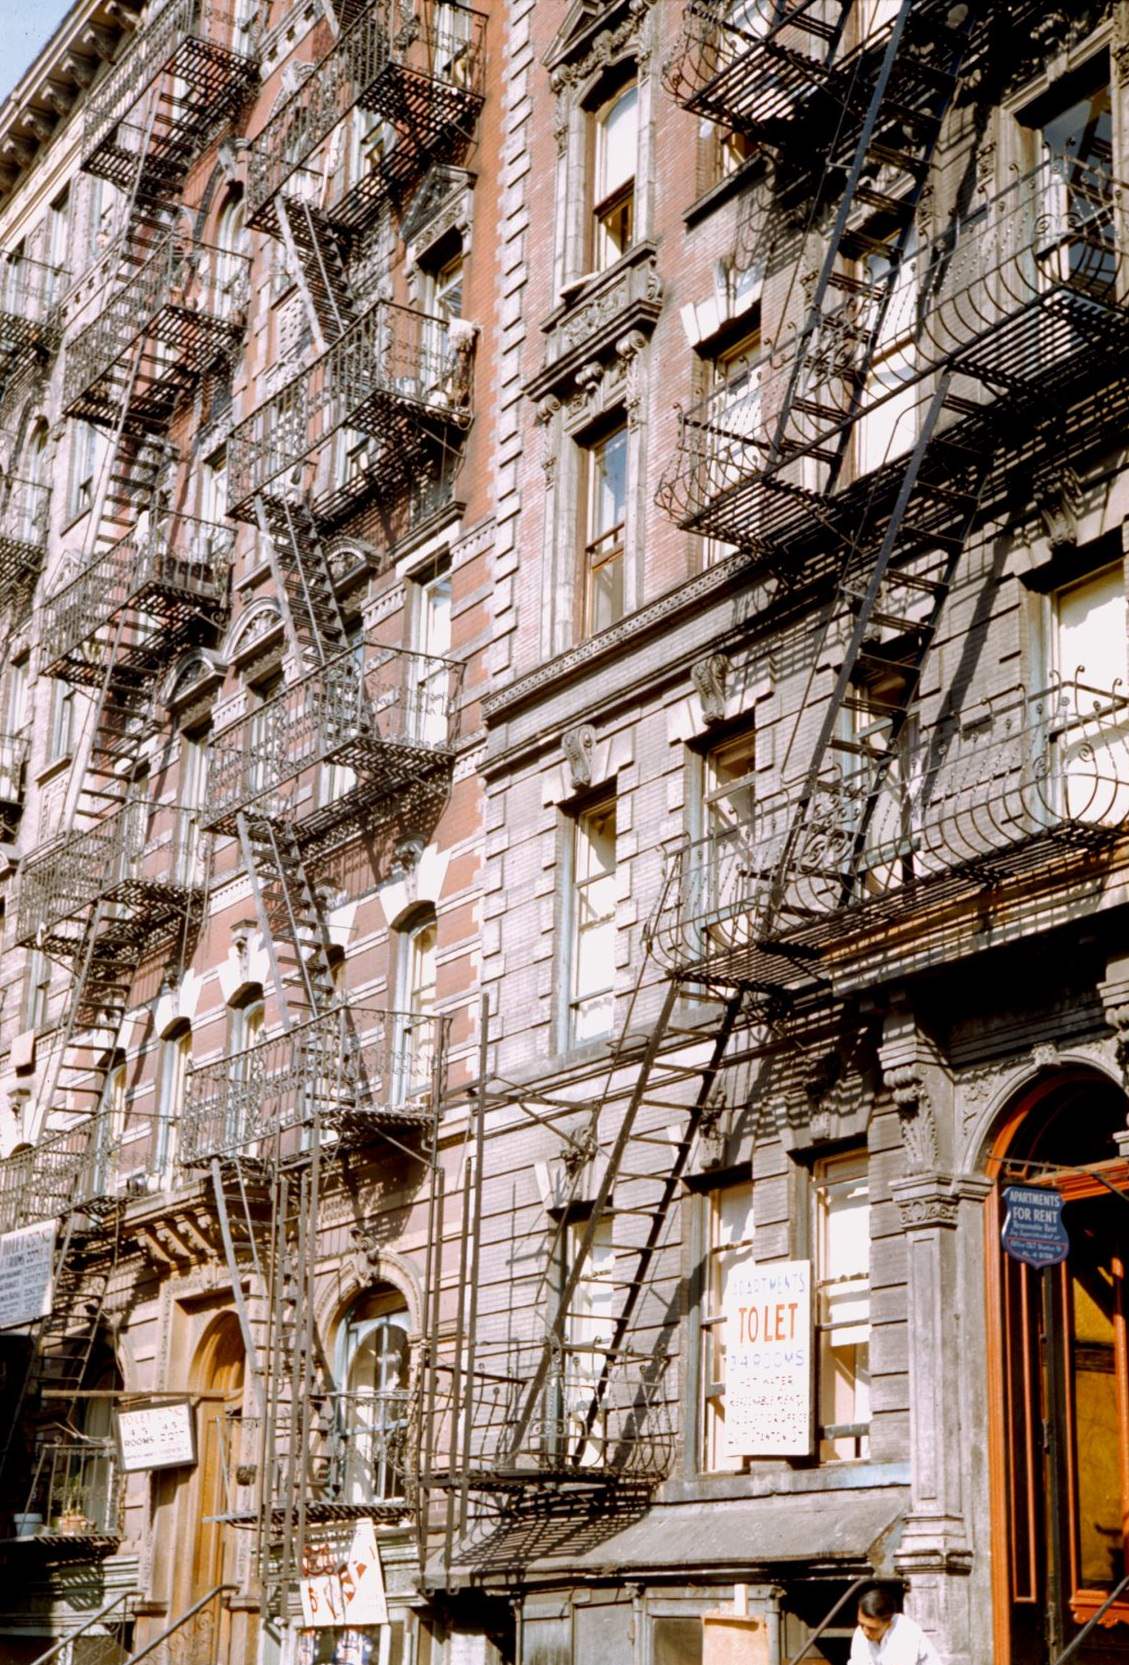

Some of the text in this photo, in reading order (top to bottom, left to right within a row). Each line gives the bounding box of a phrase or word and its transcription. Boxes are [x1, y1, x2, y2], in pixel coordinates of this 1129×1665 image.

[1008, 1191, 1060, 1208] APARTMENTS
[1012, 1206, 1058, 1224] FOR RENT
[738, 1302, 799, 1344] TO LET
